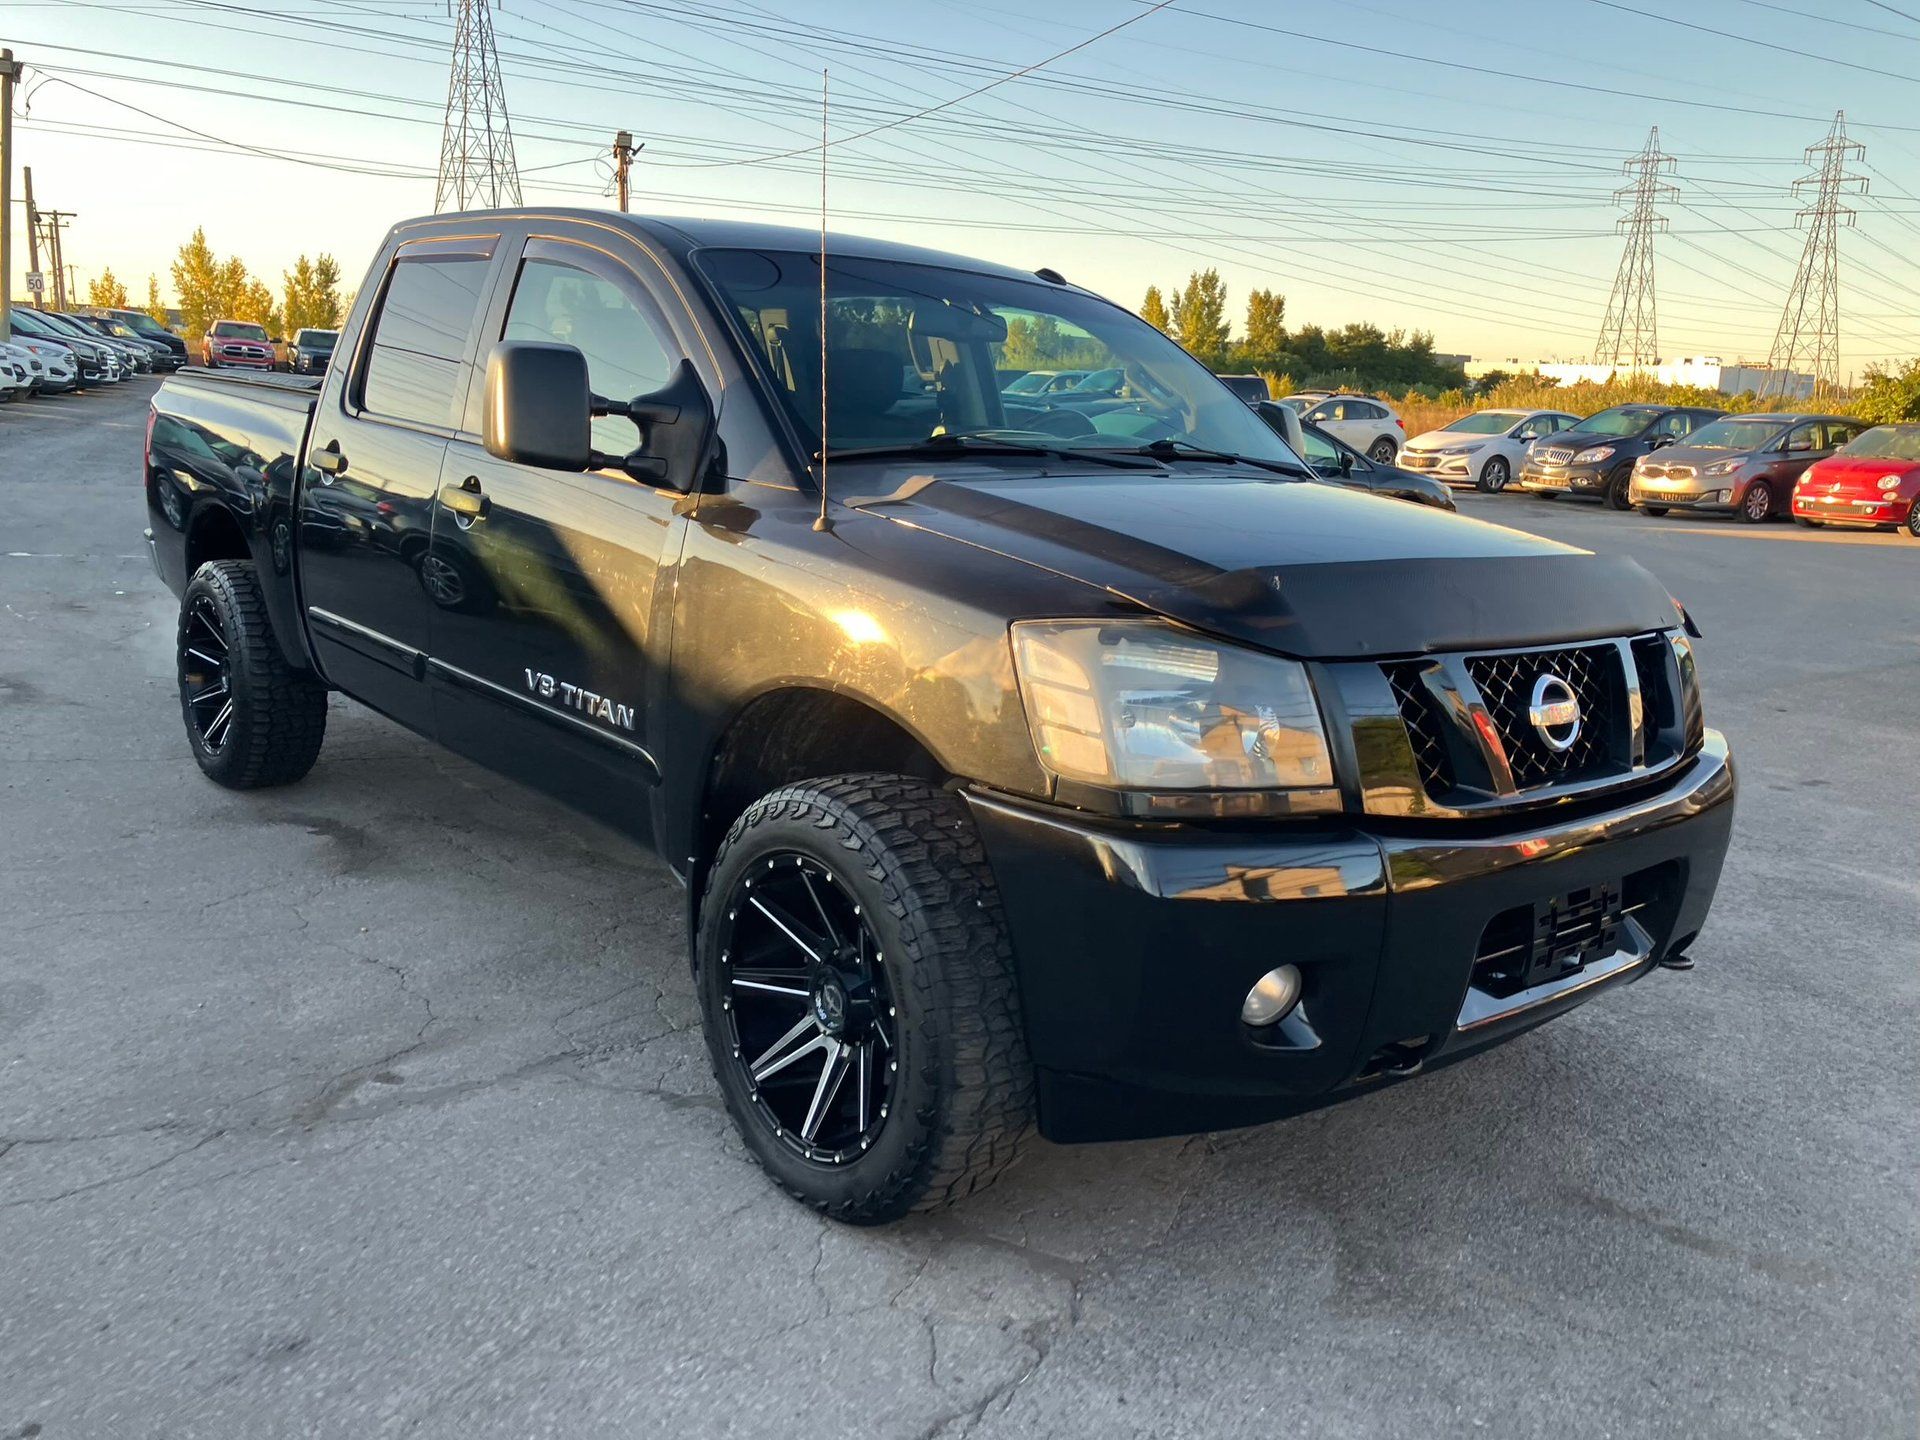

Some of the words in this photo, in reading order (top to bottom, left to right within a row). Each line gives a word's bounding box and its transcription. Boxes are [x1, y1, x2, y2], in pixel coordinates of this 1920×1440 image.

[28, 279, 42, 290] 50
[525, 668, 556, 698] V8
[560, 681, 635, 731] TITAN
